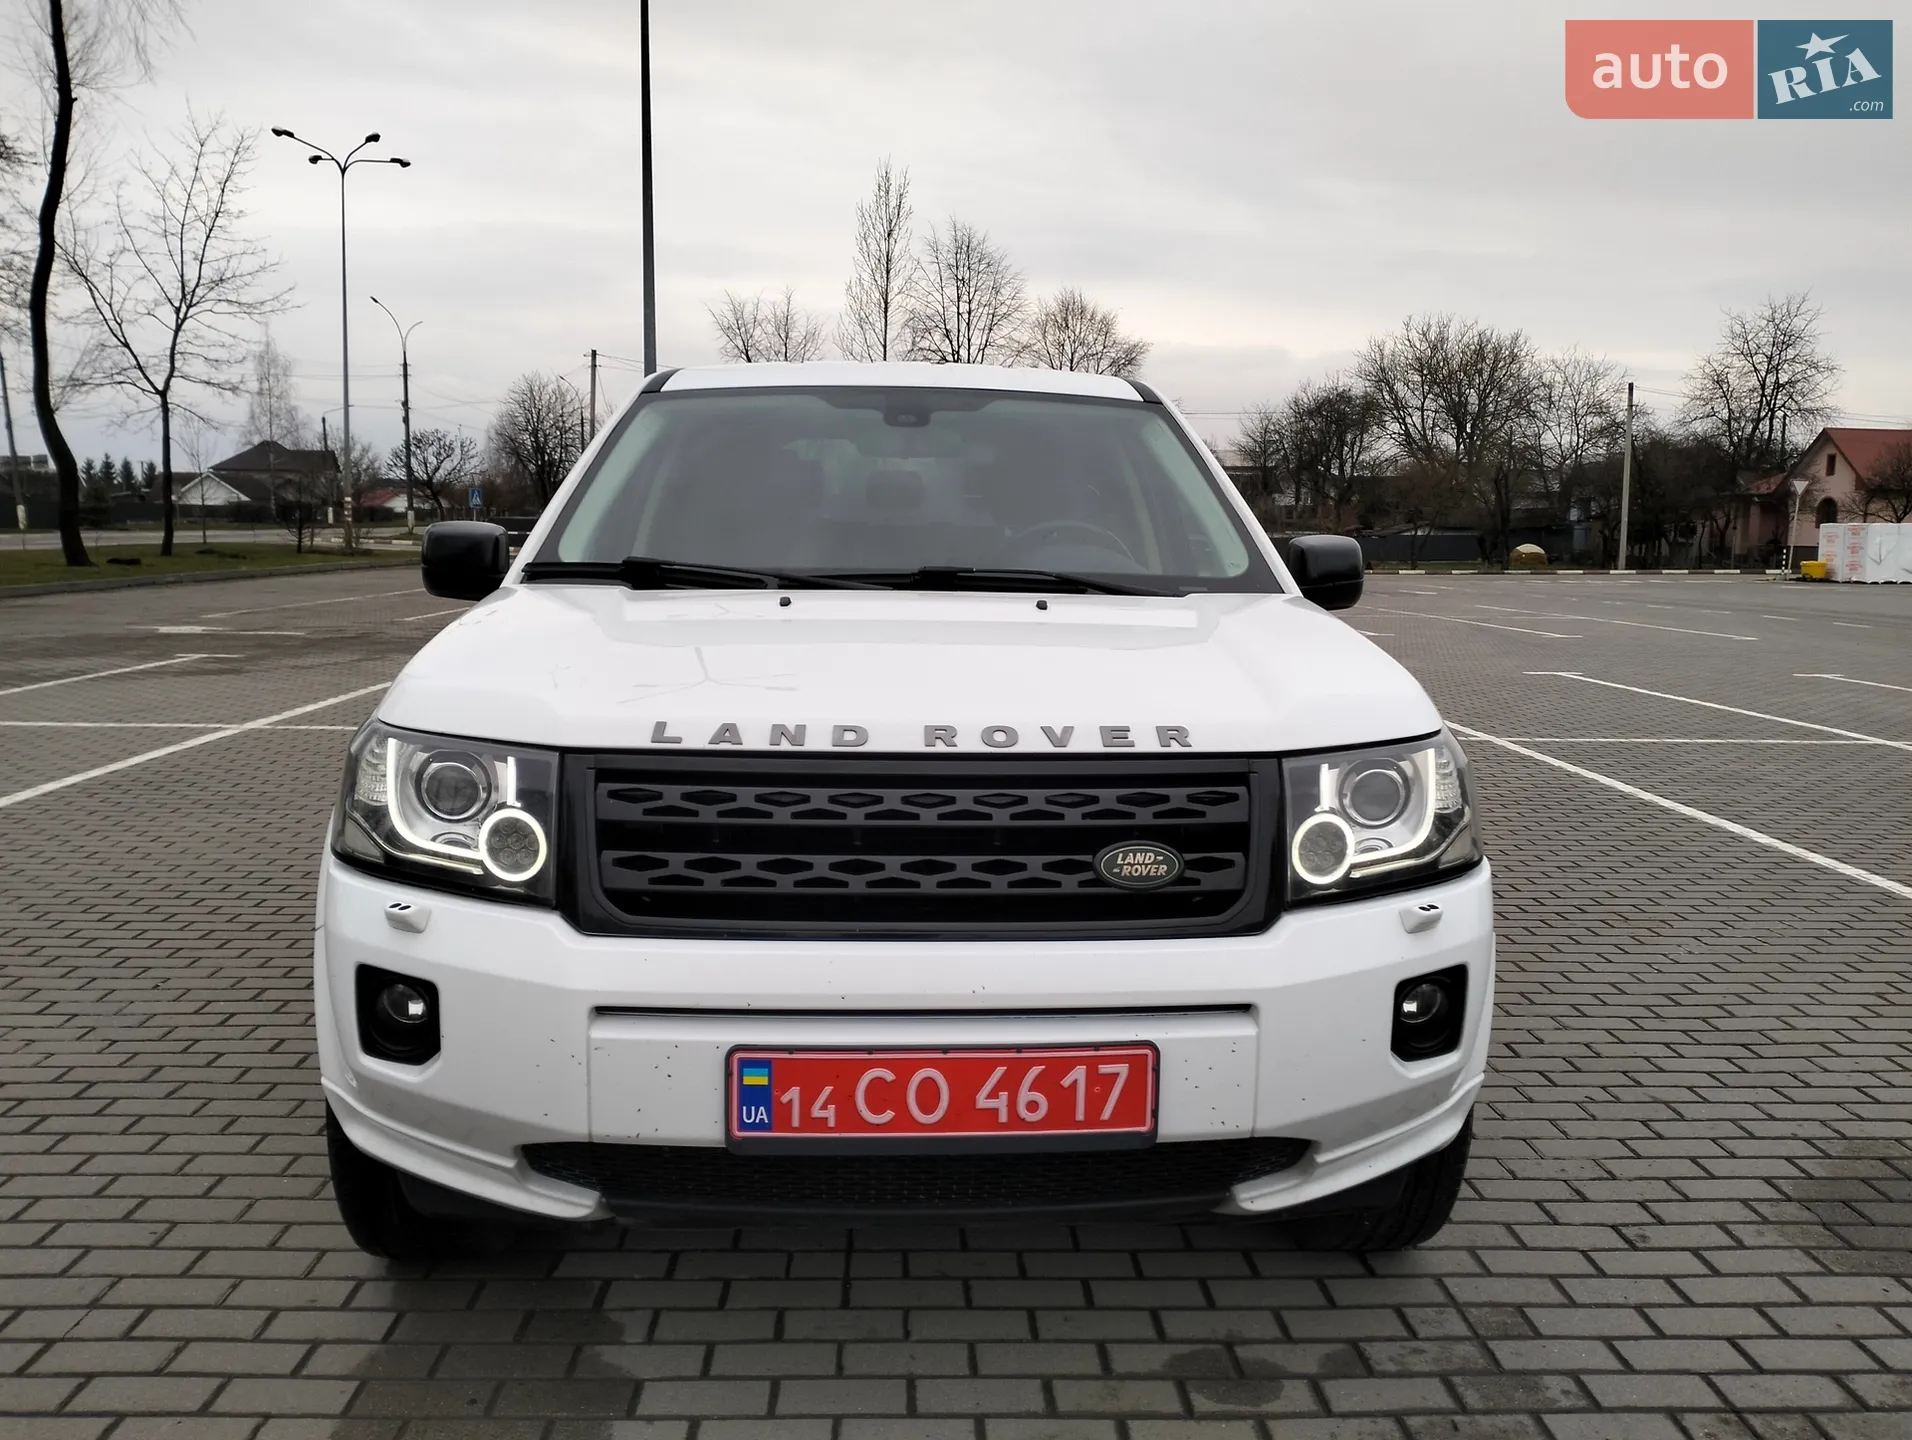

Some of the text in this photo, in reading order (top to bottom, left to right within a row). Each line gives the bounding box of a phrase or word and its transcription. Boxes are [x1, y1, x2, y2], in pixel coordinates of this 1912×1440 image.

[650, 720, 1193, 748] LAND ROVER
[1116, 852, 1155, 864] LAND
[1120, 864, 1168, 876] ROVER
[780, 1063, 1130, 1128] 14 CO 4617
[742, 1105, 769, 1124] UA
